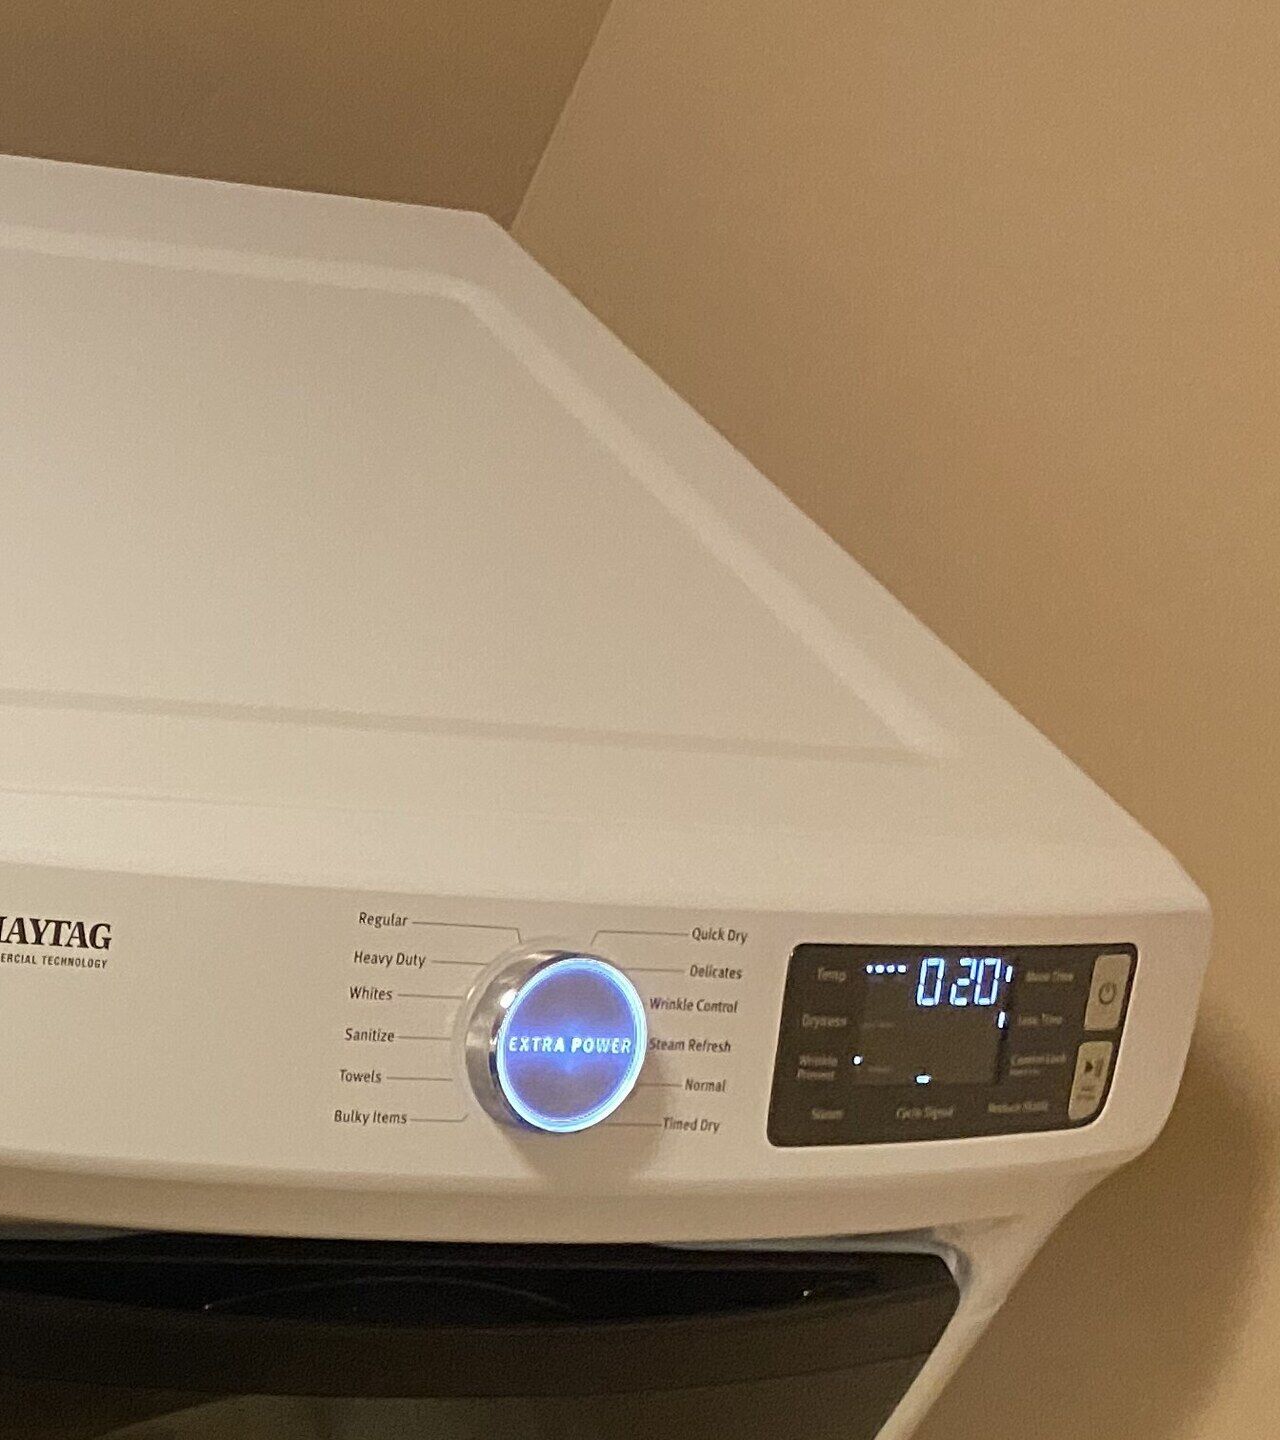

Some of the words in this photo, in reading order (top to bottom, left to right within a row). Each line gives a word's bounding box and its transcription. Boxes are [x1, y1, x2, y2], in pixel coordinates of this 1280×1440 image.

[359, 912, 408, 928] Regular
[692, 927, 724, 943] Quick
[727, 929, 748, 945] Dry
[42, 954, 108, 969] TECHNOLOGY
[354, 952, 393, 968] Heavy
[396, 953, 426, 969] Duty
[690, 966, 742, 980] Delicates
[349, 986, 392, 1000] Whites
[650, 998, 692, 1013] Wrinkle
[697, 999, 738, 1014] Control
[345, 1028, 394, 1043] Sanitize
[508, 1036, 565, 1053] EXTRA
[570, 1036, 632, 1054] POWER
[649, 1037, 685, 1052] Steam
[688, 1038, 731, 1053] Refresh
[340, 1070, 381, 1084] Towels
[685, 1078, 726, 1093] Normal
[334, 1110, 371, 1126] Bulky
[372, 1110, 407, 1125] Items
[663, 1117, 697, 1132] Timed
[700, 1118, 720, 1133] Dry
